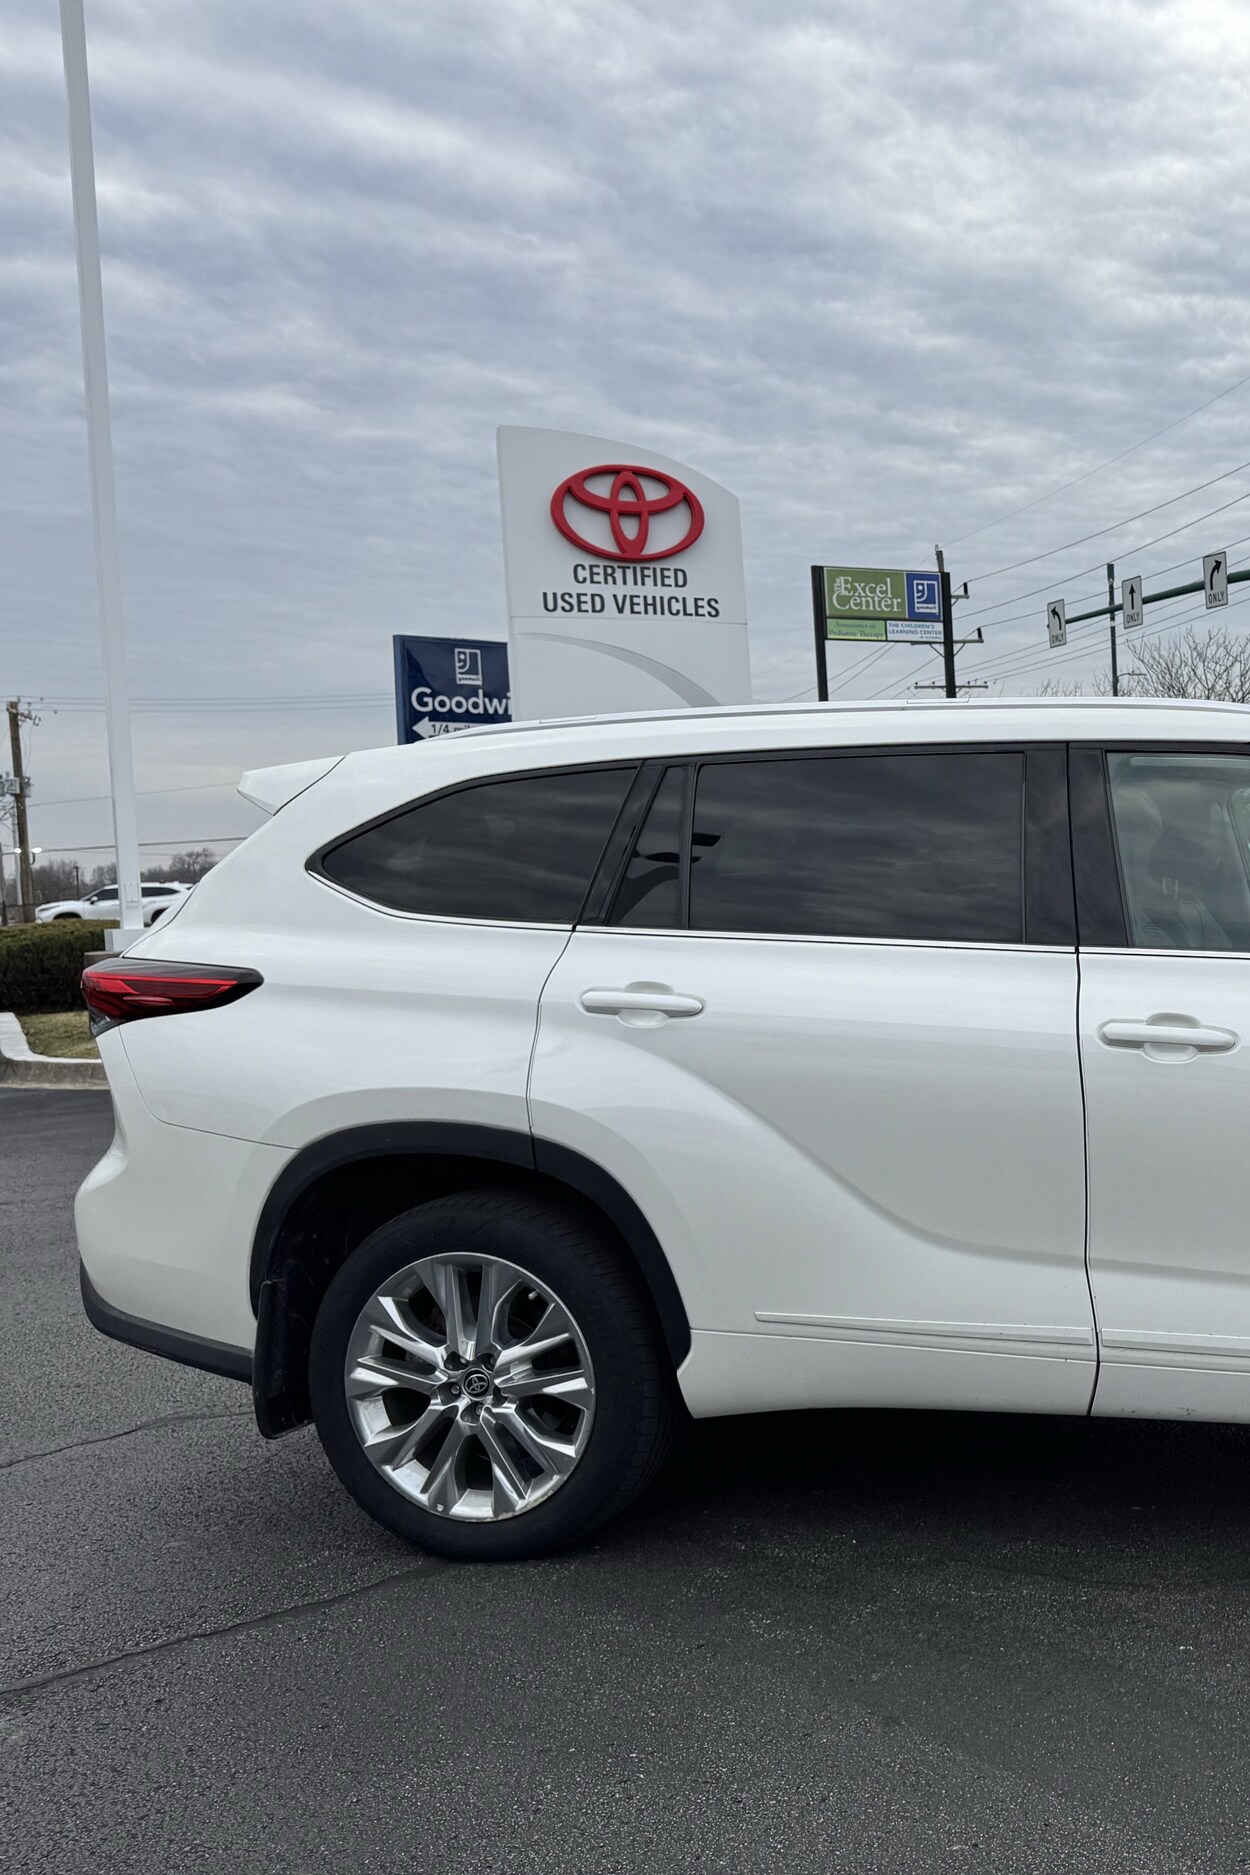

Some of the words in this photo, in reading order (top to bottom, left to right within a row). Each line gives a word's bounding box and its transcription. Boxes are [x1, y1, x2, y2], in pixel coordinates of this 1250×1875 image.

[573, 563, 688, 588] CERTIFIED
[839, 576, 893, 598] Excel
[542, 592, 606, 613] USED
[612, 594, 720, 618] VEHICLES
[832, 590, 902, 612] Center
[1208, 590, 1225, 605] ONLY
[1126, 611, 1141, 625] ONLY
[1051, 633, 1065, 645] ONLY
[431, 723, 450, 735] 1/4
